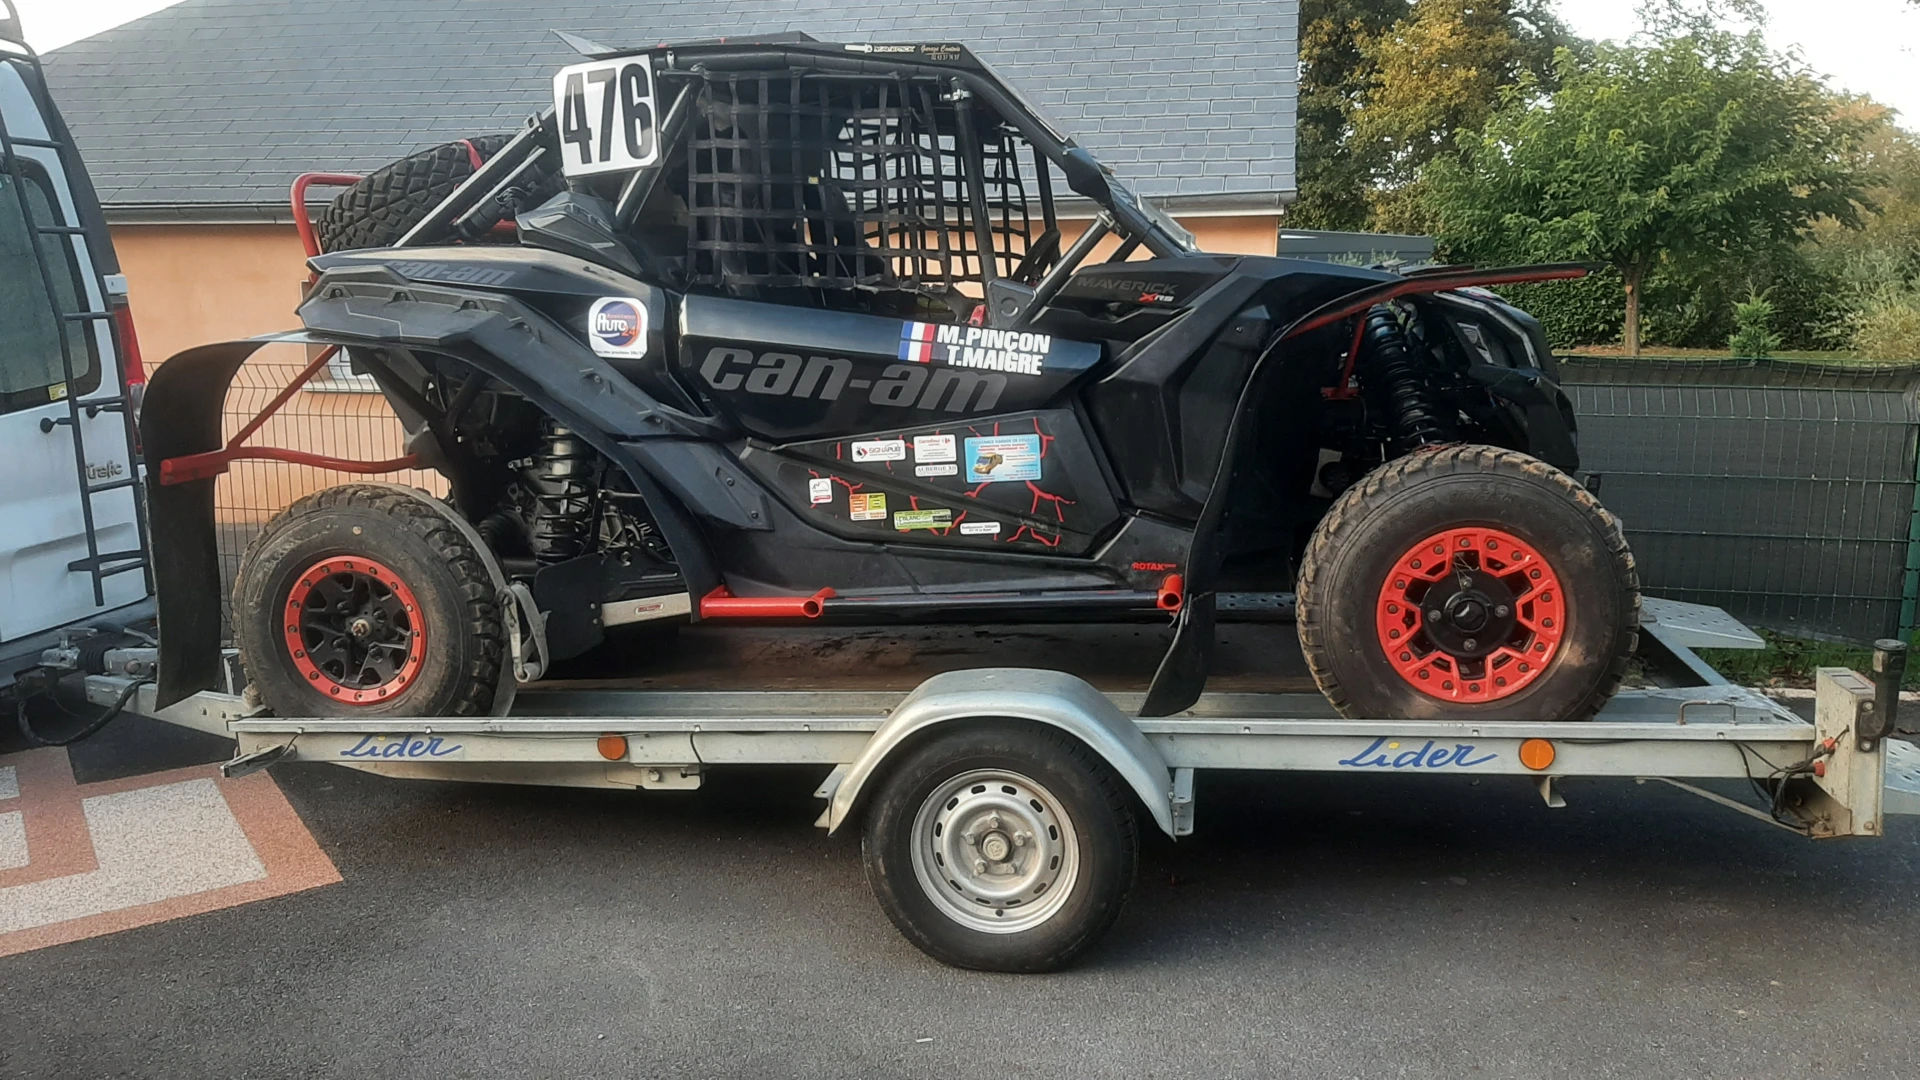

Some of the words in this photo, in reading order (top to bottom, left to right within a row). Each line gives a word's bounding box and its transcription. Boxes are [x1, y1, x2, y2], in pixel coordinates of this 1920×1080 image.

[563, 63, 653, 165] 476
[385, 260, 516, 285] can-am
[1077, 277, 1178, 294] MAVERICK
[621, 325, 637, 337] 24
[937, 324, 1051, 354] M.PINÇON
[947, 345, 1044, 376] T.MAIGRE
[700, 347, 1007, 413] can-am
[86, 460, 123, 480] Trafic
[1131, 562, 1165, 571] ROTAX
[340, 733, 463, 758] Lider
[1338, 736, 1499, 768] Lider
